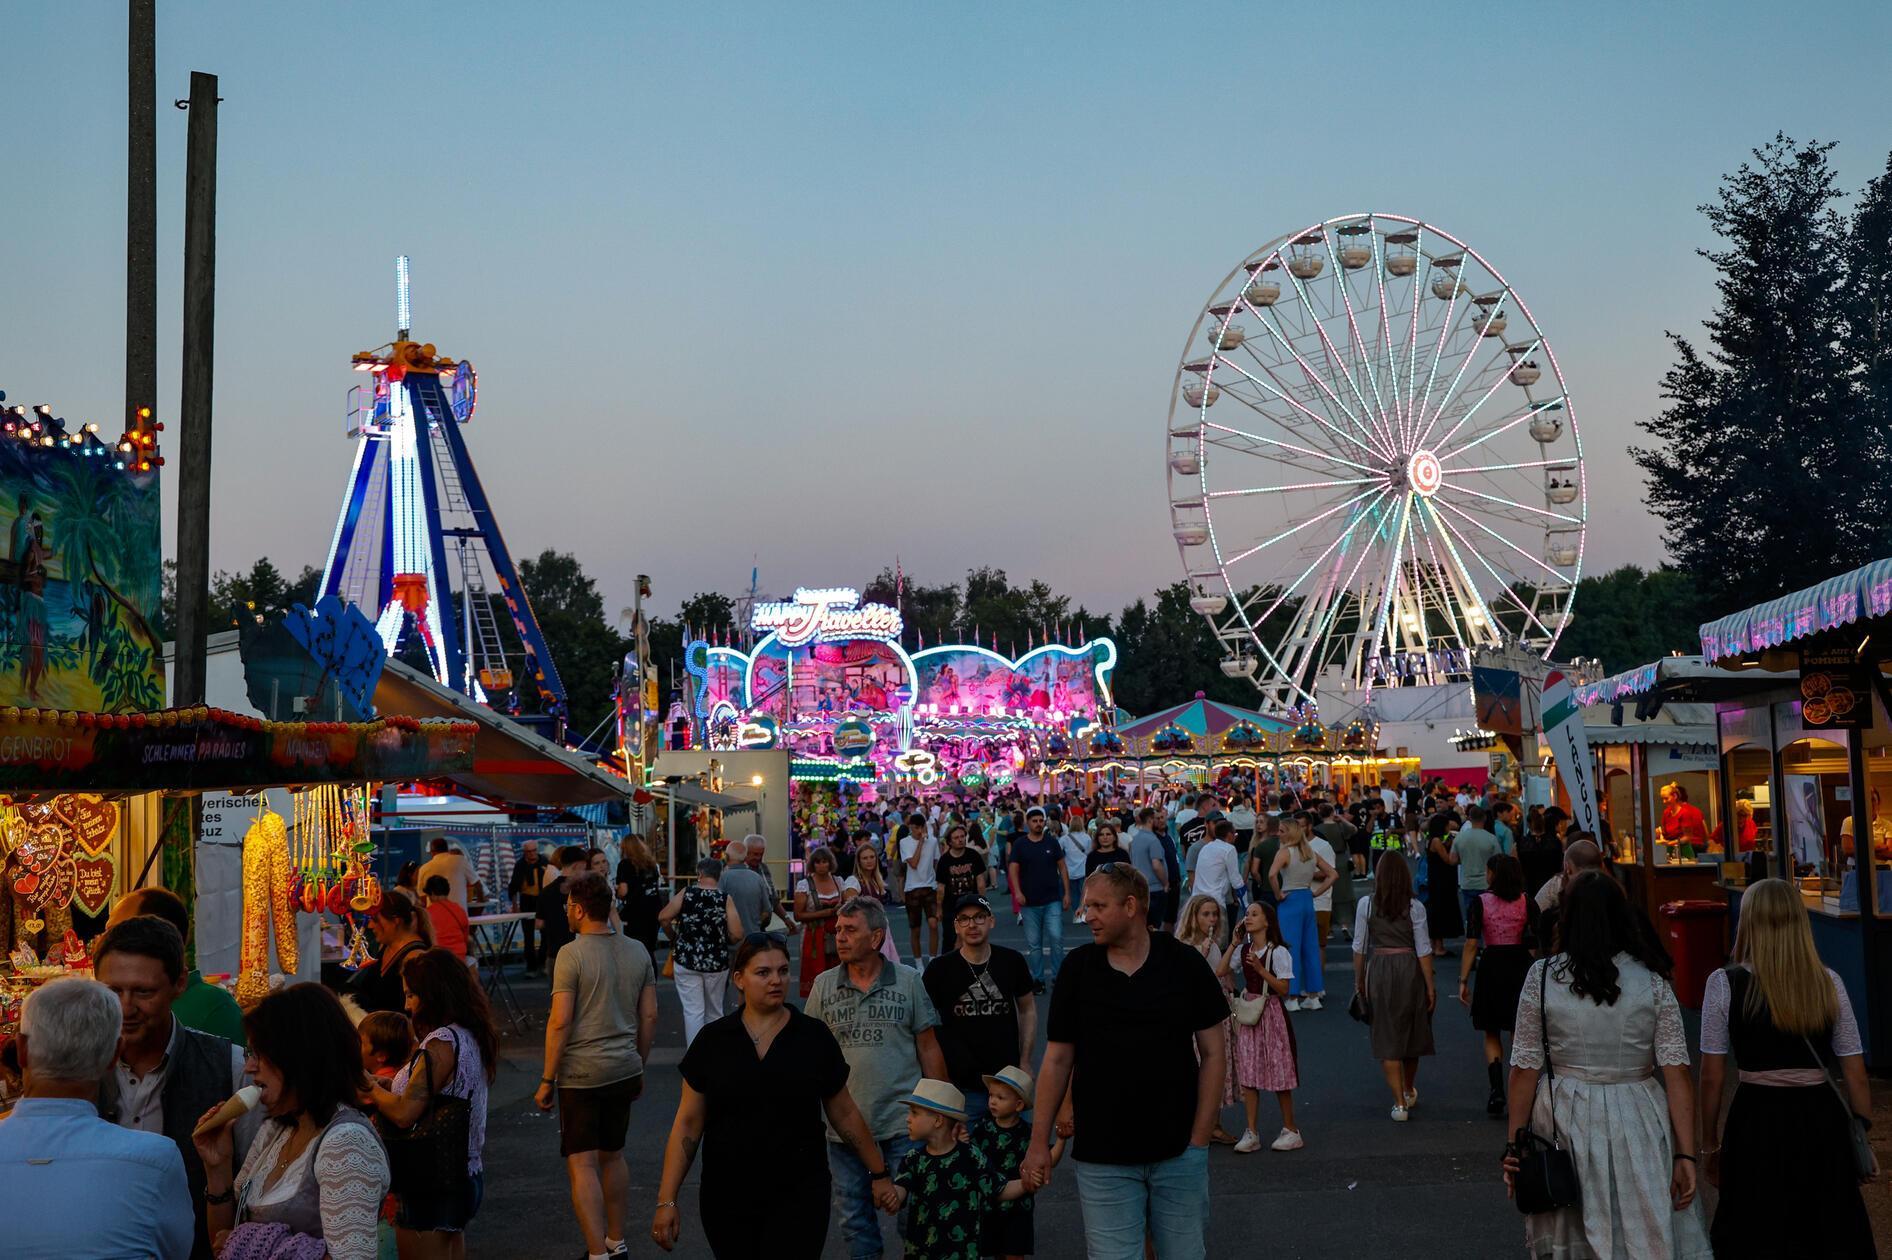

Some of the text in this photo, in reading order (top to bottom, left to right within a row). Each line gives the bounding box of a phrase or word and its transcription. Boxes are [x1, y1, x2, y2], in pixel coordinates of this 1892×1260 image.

[1, 735, 73, 762] GENBROT
[141, 740, 247, 764] SCHLEMMER PARADIES
[80, 868, 91, 879] Du
[91, 866, 102, 878] bist
[868, 1004, 905, 1021] DAVID
[952, 999, 1010, 1017] adidas
